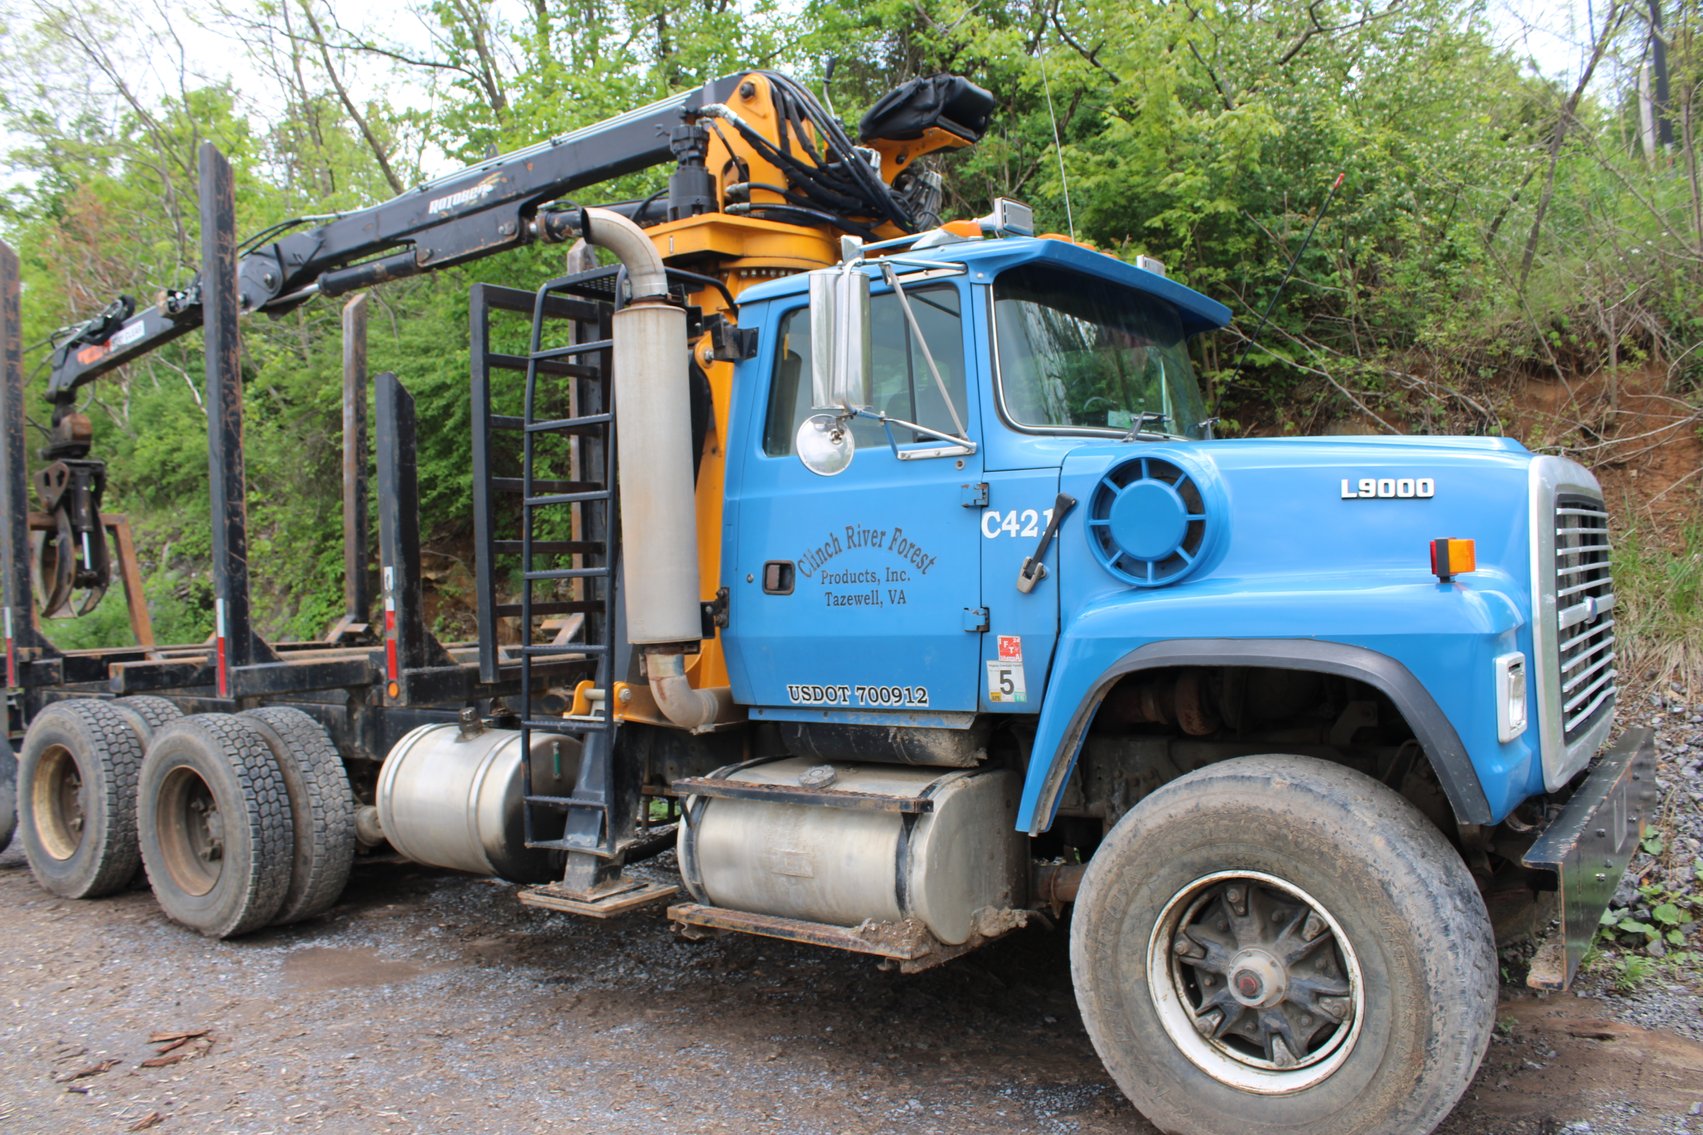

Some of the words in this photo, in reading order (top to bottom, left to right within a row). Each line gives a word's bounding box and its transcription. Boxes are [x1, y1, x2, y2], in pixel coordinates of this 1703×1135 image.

[1340, 478, 1434, 500] L9000
[797, 531, 843, 578] Clinch
[845, 524, 887, 550] River
[889, 527, 937, 575] Forest
[820, 569, 881, 586] Products,
[885, 566, 911, 583] Inc.
[824, 589, 883, 608] Tazewell,
[887, 589, 907, 605] VA
[1000, 670, 1014, 695] 5
[787, 685, 850, 704] USDOT
[855, 686, 929, 707] 700912
